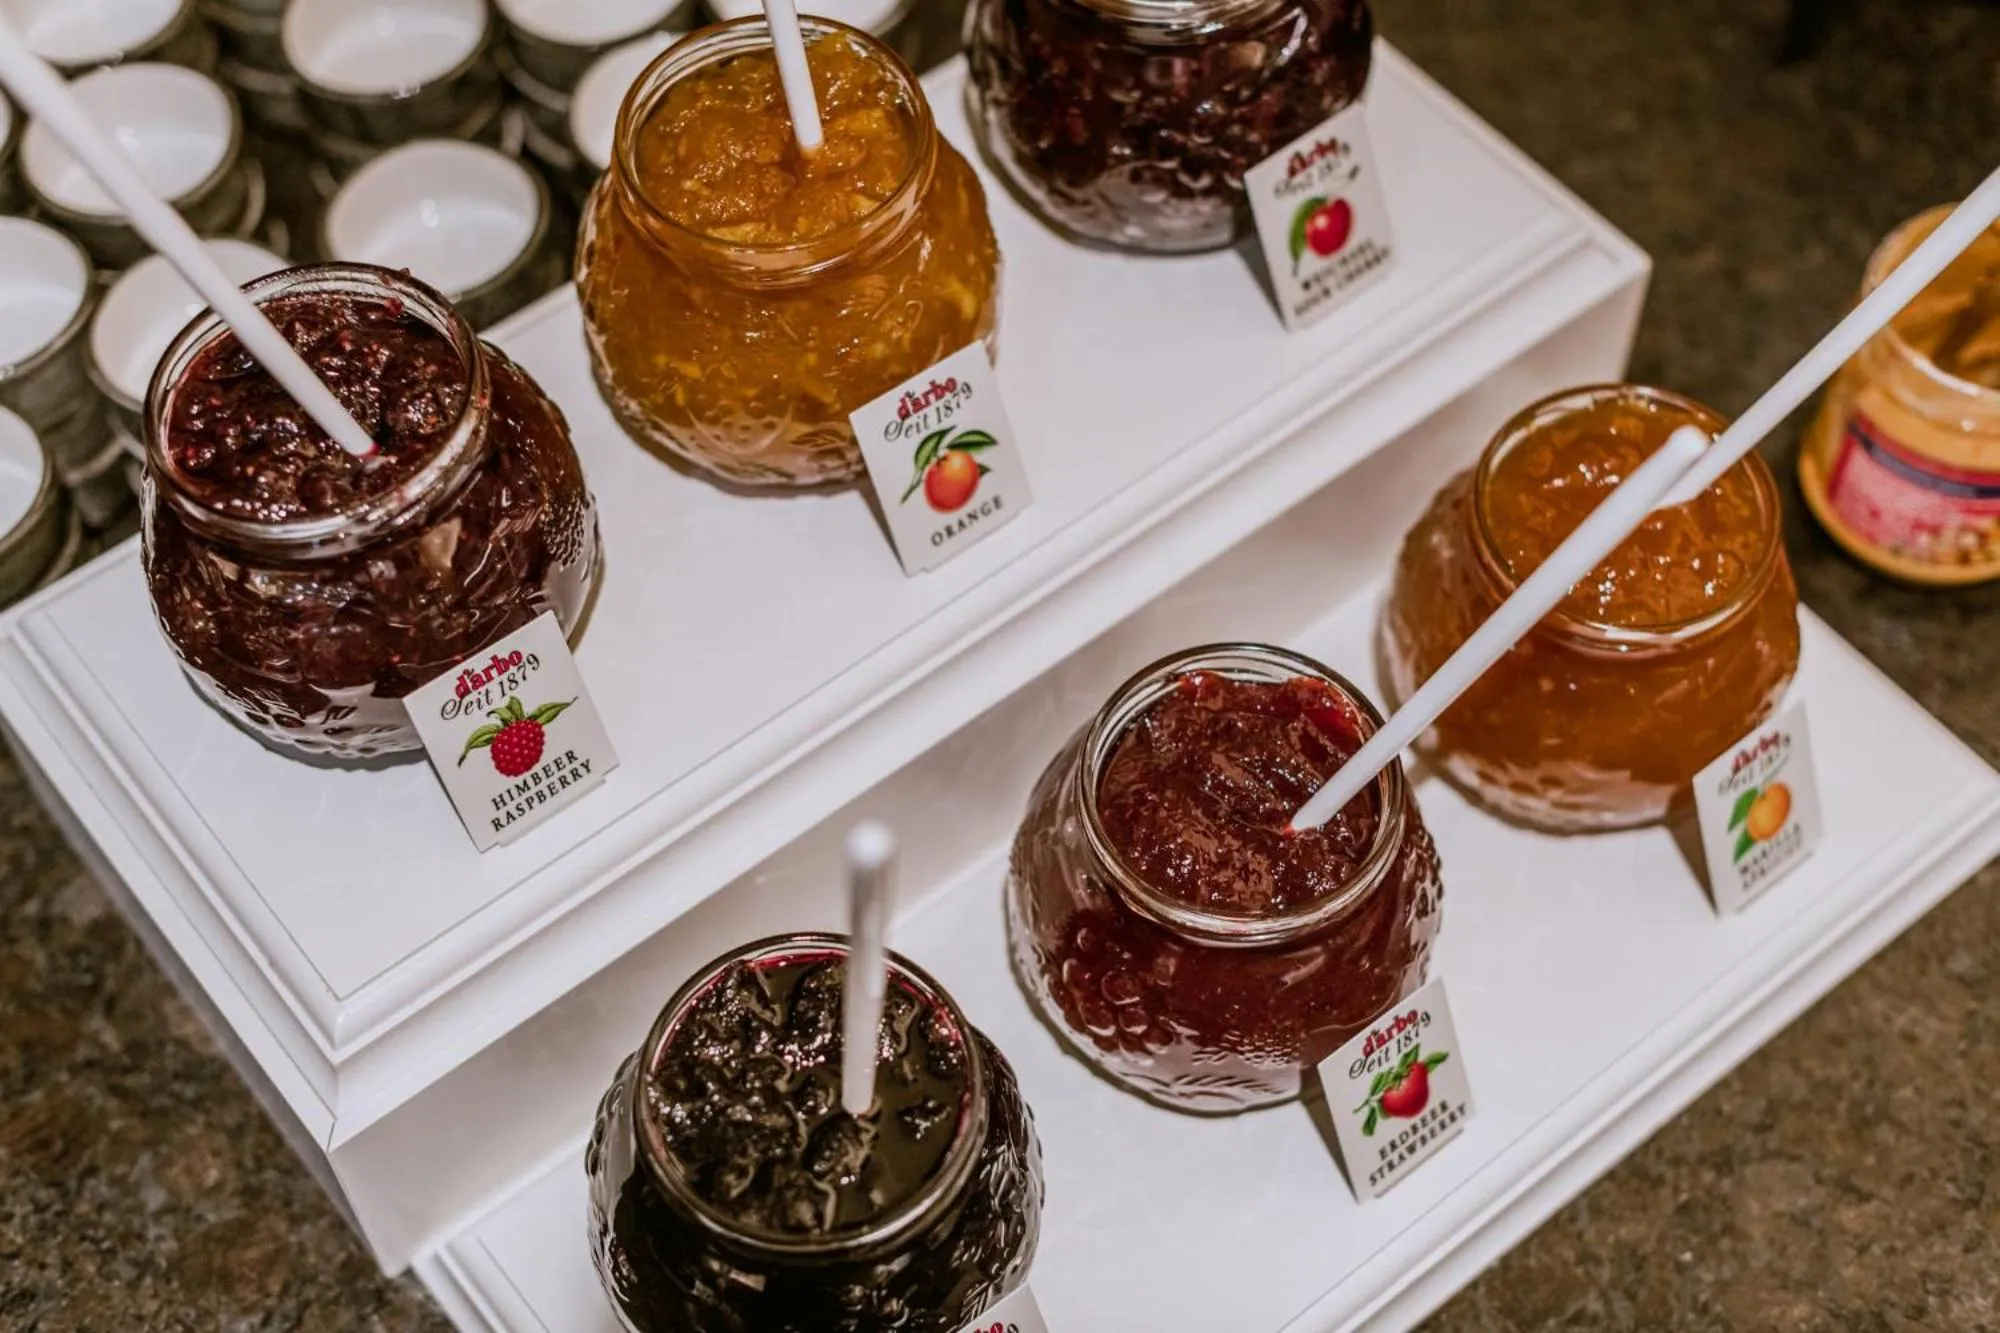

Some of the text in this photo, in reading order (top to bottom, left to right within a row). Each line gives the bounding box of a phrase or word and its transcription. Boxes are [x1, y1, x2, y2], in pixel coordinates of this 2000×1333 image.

[884, 382, 973, 442] Seit 1879
[931, 495, 1003, 547] ORANGE
[440, 653, 540, 720] Seit 1879
[490, 759, 593, 832] RASPBERRY
[491, 750, 579, 811] HIMBEER
[1349, 1011, 1431, 1079] Seit 1879
[1368, 1102, 1467, 1186] STRAWBERRY
[1378, 1100, 1450, 1161] ERDBEER
